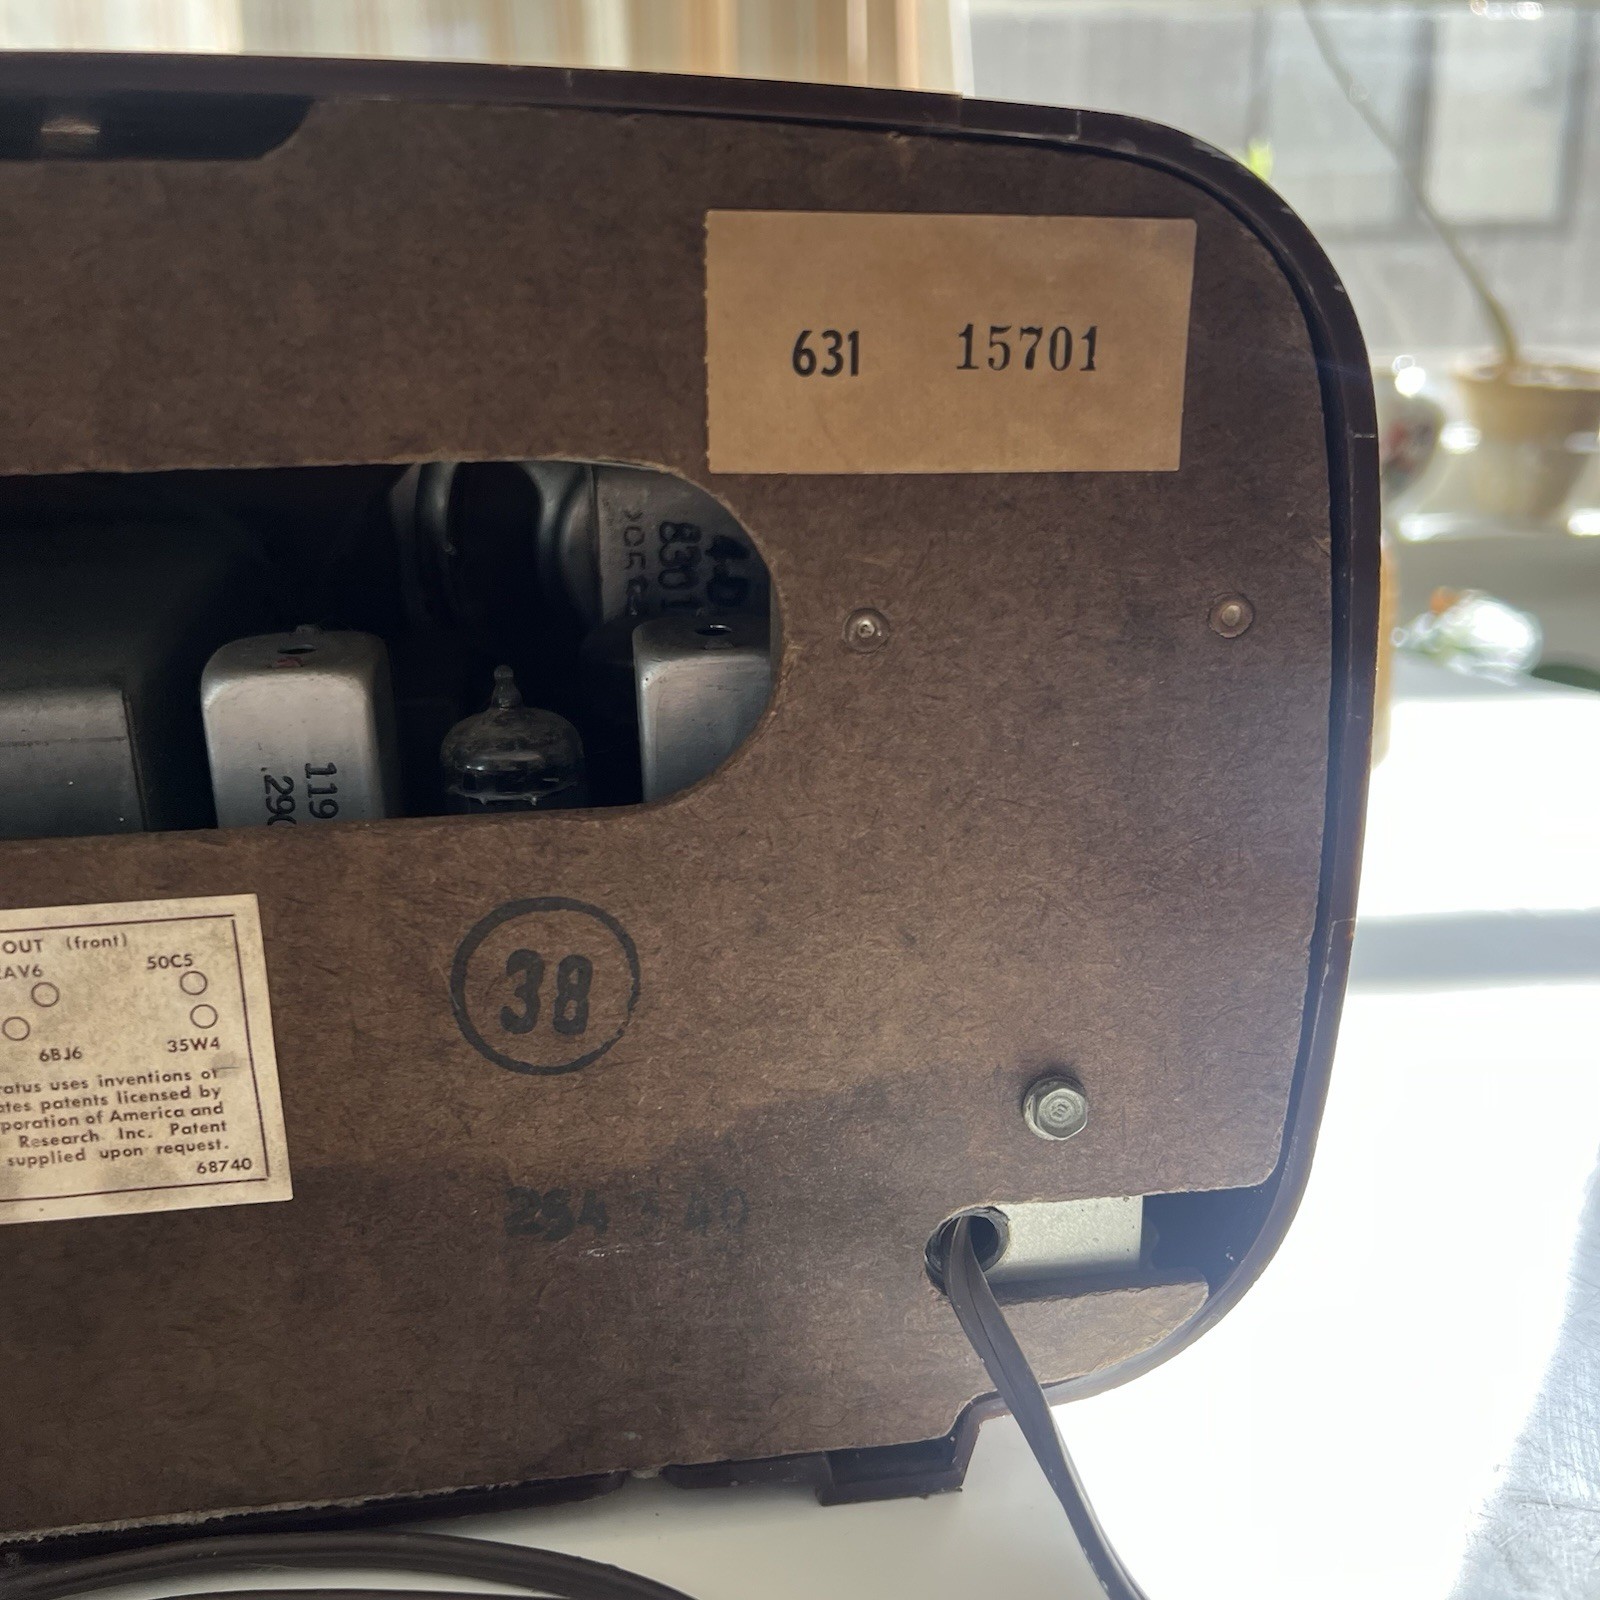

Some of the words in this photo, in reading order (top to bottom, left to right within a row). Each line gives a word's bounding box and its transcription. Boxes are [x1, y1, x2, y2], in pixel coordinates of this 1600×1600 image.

[791, 329, 860, 378] 631
[955, 323, 1098, 372] 15701
[658, 521, 702, 609] 8301
[304, 762, 340, 820] 119
[2, 939, 44, 955] OUT
[66, 932, 128, 951] (front)
[0, 964, 44, 979] AV6
[146, 953, 194, 970] 50C5
[500, 947, 594, 1036] 38
[39, 1046, 83, 1063] 6BJ6
[167, 1037, 220, 1053] 35W4
[50, 1079, 89, 1092] uses
[97, 1070, 192, 1088] inventions
[40, 1095, 109, 1114] patents
[117, 1085, 192, 1105] licensed
[199, 1085, 221, 1100] by
[0, 1114, 79, 1134] poration
[85, 1110, 104, 1124] of
[109, 1106, 185, 1123] America
[191, 1101, 224, 1116] and
[19, 1129, 101, 1148] Research
[118, 1127, 153, 1140] Inc.
[170, 1120, 227, 1136] Patent
[8, 1147, 87, 1168] supplied
[100, 1147, 144, 1161] upon
[157, 1139, 230, 1156] request.
[197, 1158, 252, 1174] 68740
